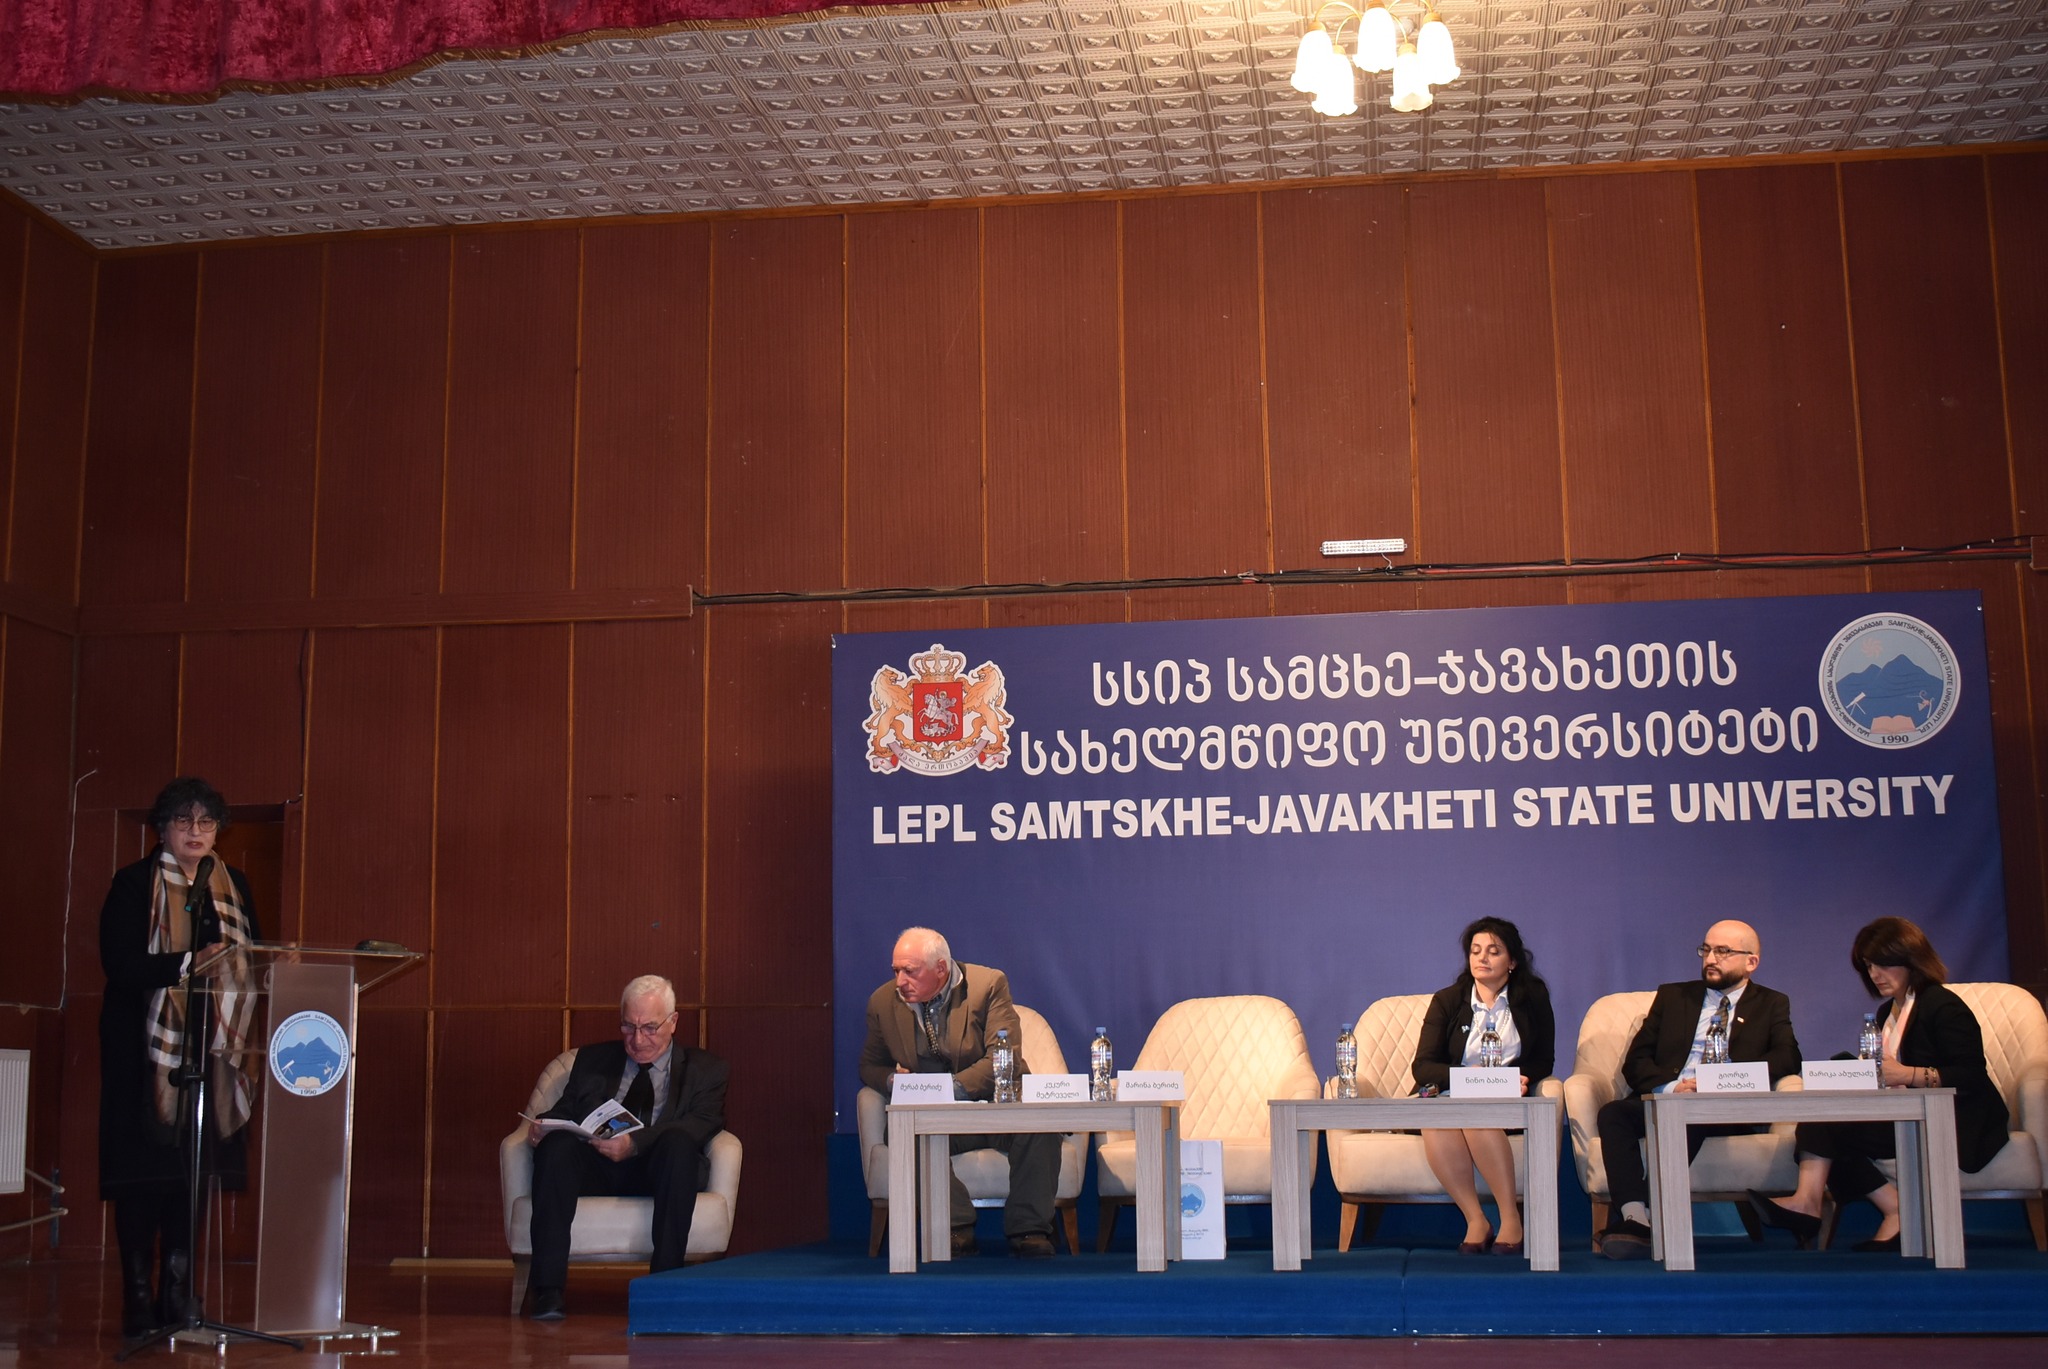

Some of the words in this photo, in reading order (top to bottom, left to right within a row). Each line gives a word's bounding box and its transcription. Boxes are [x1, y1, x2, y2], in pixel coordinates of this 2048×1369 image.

[1092, 658, 1213, 707] სსიპ
[1944, 665, 1954, 686] STATE
[1020, 719, 1387, 776] სახელმწიფო
[1399, 706, 1818, 765] უნივერსიტეტი
[1881, 734, 1910, 744] 1990
[873, 804, 977, 844] LEPL
[990, 788, 1497, 842] SAMTSKHE-JAVAKHETI
[1512, 784, 1655, 828] STATE
[1669, 774, 1954, 823] UNIVERSITY
